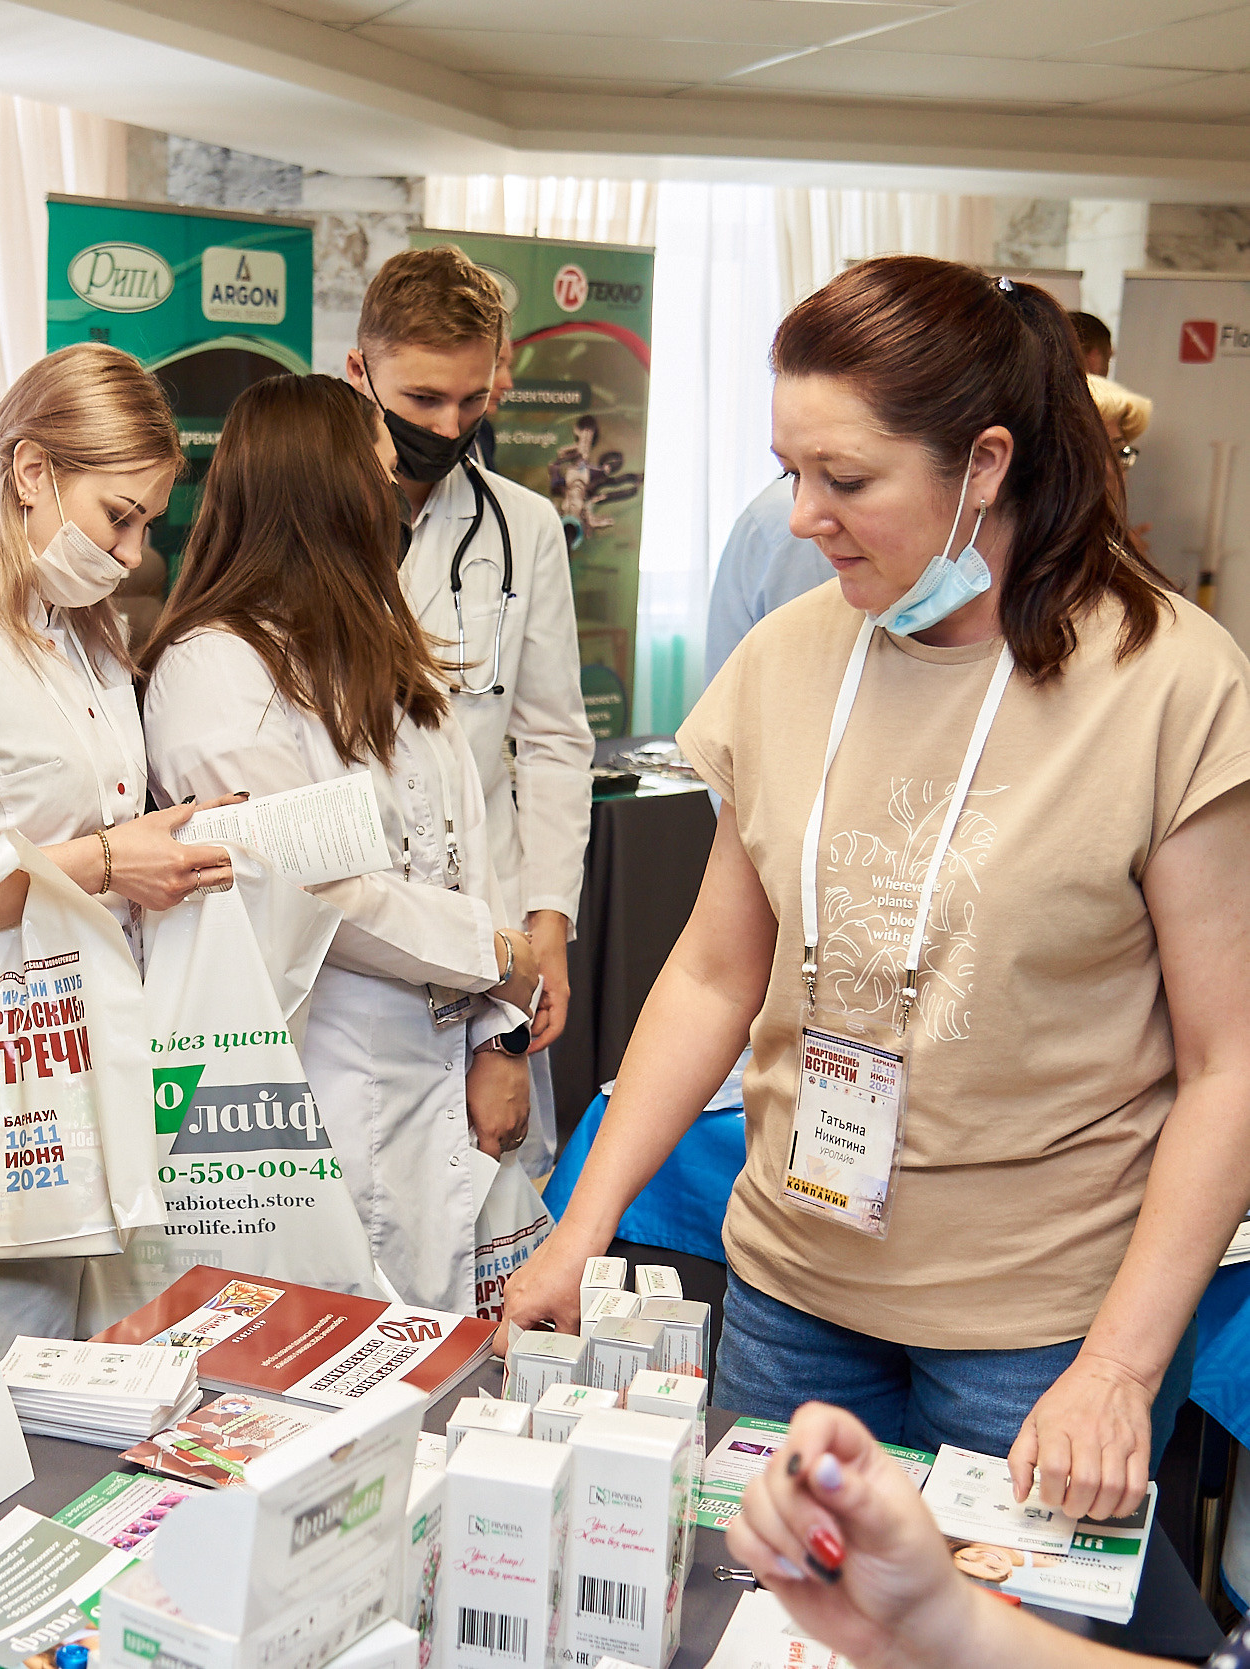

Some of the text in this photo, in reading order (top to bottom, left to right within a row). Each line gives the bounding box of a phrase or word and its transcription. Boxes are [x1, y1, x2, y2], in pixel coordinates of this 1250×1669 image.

[211, 284, 279, 307] ARGON
[872, 875, 923, 893] Whereve
[877, 893, 913, 908] plants
[889, 912, 915, 927] bloo
[873, 928, 901, 942] with
[54, 974, 82, 995] КЛУБ
[806, 1046, 859, 1067] «МАРТОВСКИЕ»
[872, 1057, 896, 1069] БАРНАУЛ
[805, 1055, 857, 1083] ВСТРЕЧИ
[872, 1064, 895, 1078] 10-11
[869, 1081, 894, 1095] 2021
[871, 1072, 895, 1086] ИЮНЯ
[4, 1110, 57, 1128] БАРНАУЛ
[188, 1090, 325, 1141] лайф
[821, 1109, 866, 1136] Татьяна
[6, 1125, 61, 1149] 10-11
[815, 1127, 866, 1155] Никитина
[5, 1145, 65, 1169] ИЮНЯ
[820, 1147, 855, 1165] УРОЛАЙФ
[6, 1164, 69, 1192] 2021
[166, 1193, 315, 1211] rabiotech.store
[787, 1180, 847, 1208] КОМПАНИИ
[164, 1218, 276, 1236] urolife.info
[309, 1338, 384, 1391] ОБРАЗОВАНИЕ
[326, 1341, 402, 1395] МЕДИЦИНСКОЕ
[345, 1344, 418, 1397] НЕПРЕРЫВНОЕ
[612, 1491, 642, 1503] RIVIERA
[491, 1521, 522, 1533] RIVIERA
[14, 1536, 36, 1552] при
[61, 1538, 81, 1552] для
